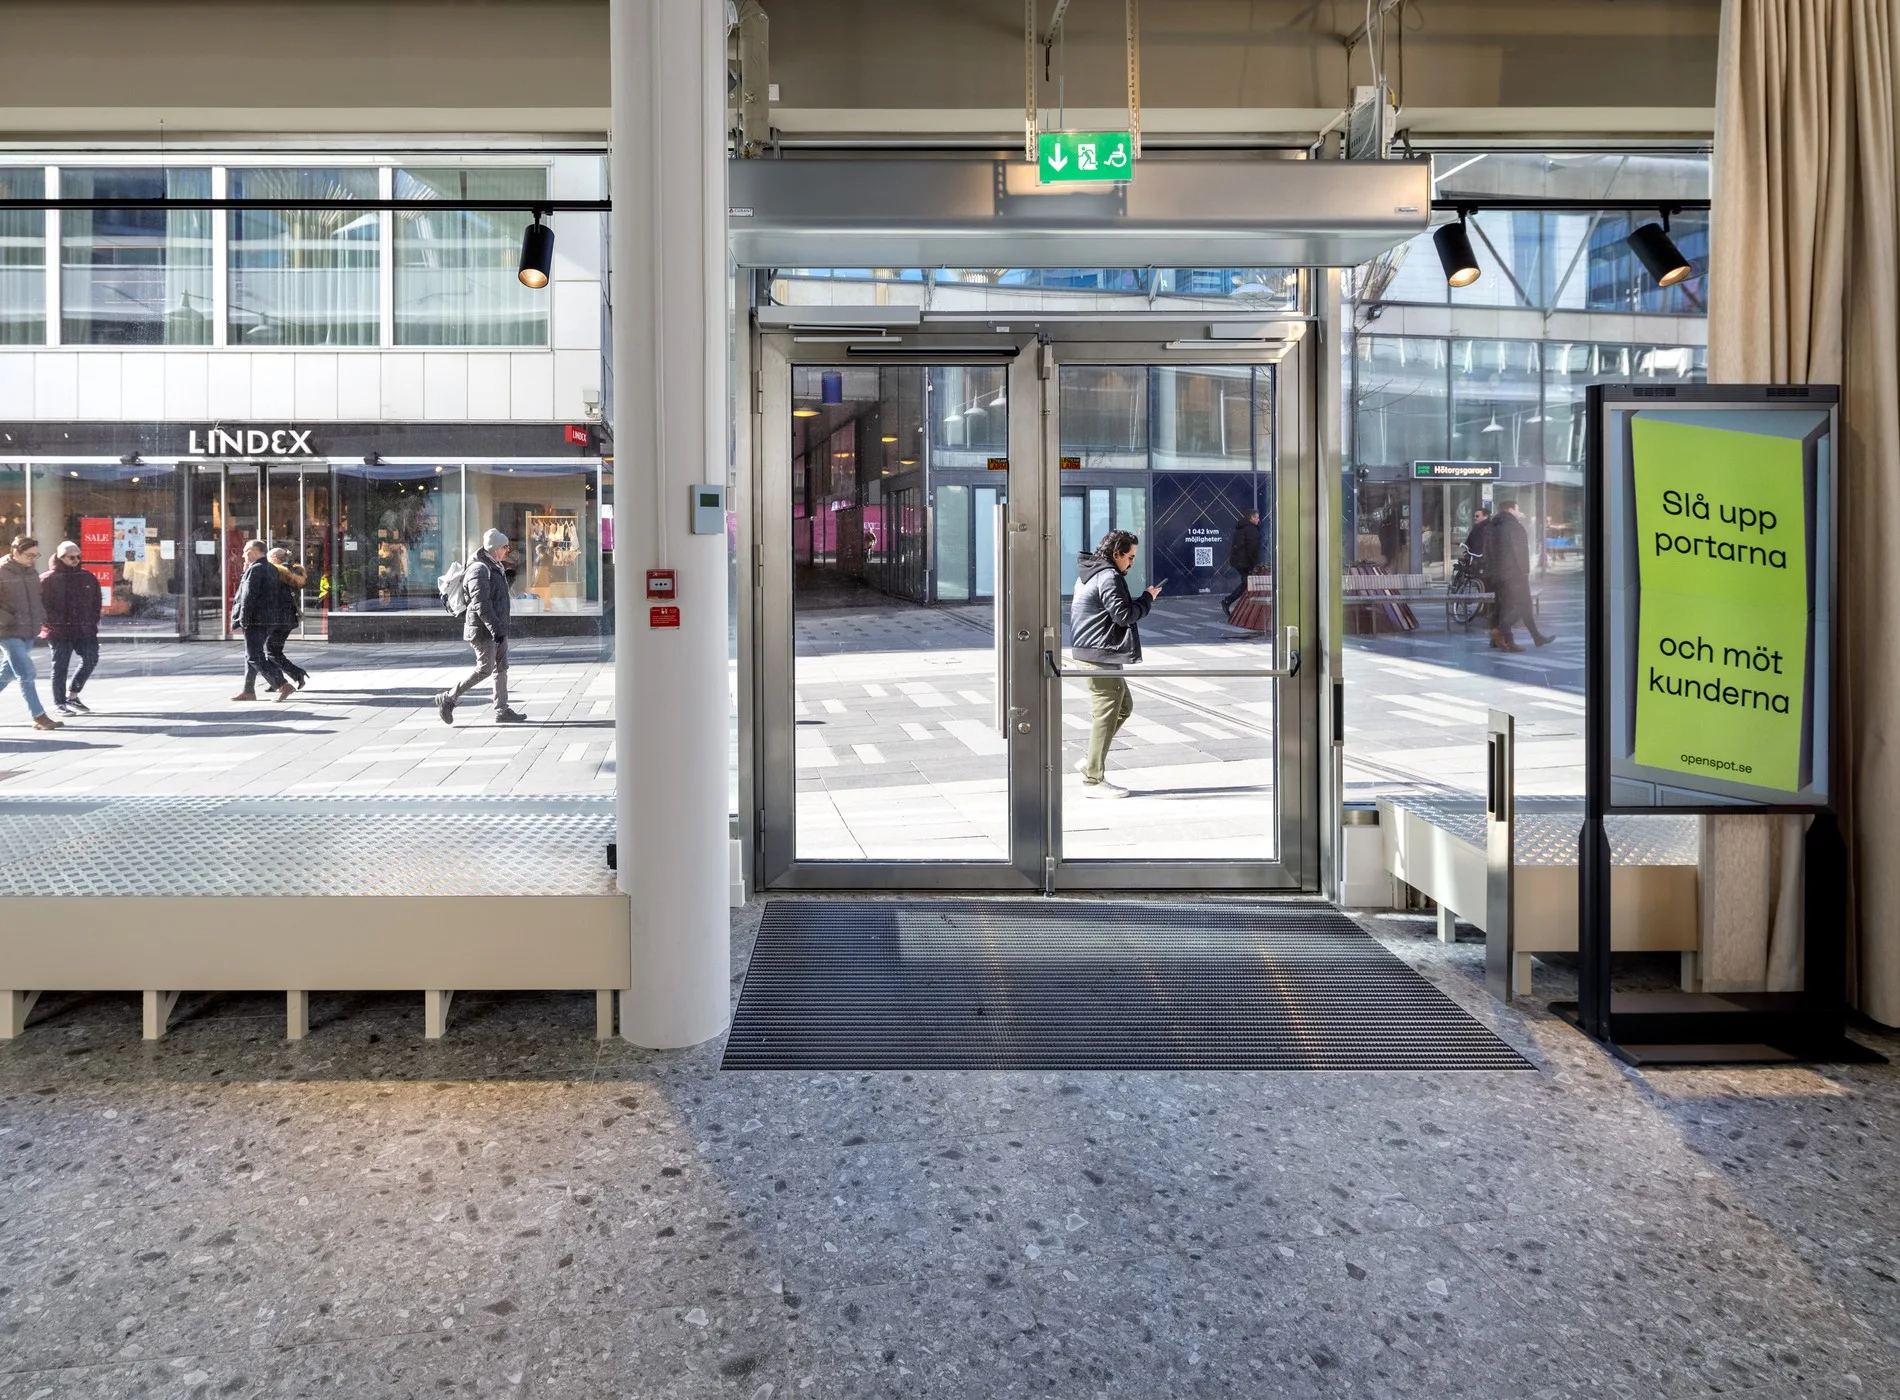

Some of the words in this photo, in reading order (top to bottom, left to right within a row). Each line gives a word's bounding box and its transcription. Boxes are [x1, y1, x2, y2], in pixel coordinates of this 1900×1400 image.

[189, 429, 313, 454] LINDEX
[1434, 465, 1493, 476] Hötorgsgaraget
[1663, 490, 1710, 521] Slå
[1720, 504, 1777, 535] upp
[85, 533, 109, 542] SALE
[1655, 532, 1787, 570] portarna
[1659, 636, 1714, 664] och
[1723, 645, 1784, 675] möt
[1649, 667, 1790, 715] kunderna
[1680, 754, 1753, 774] openspot.se
